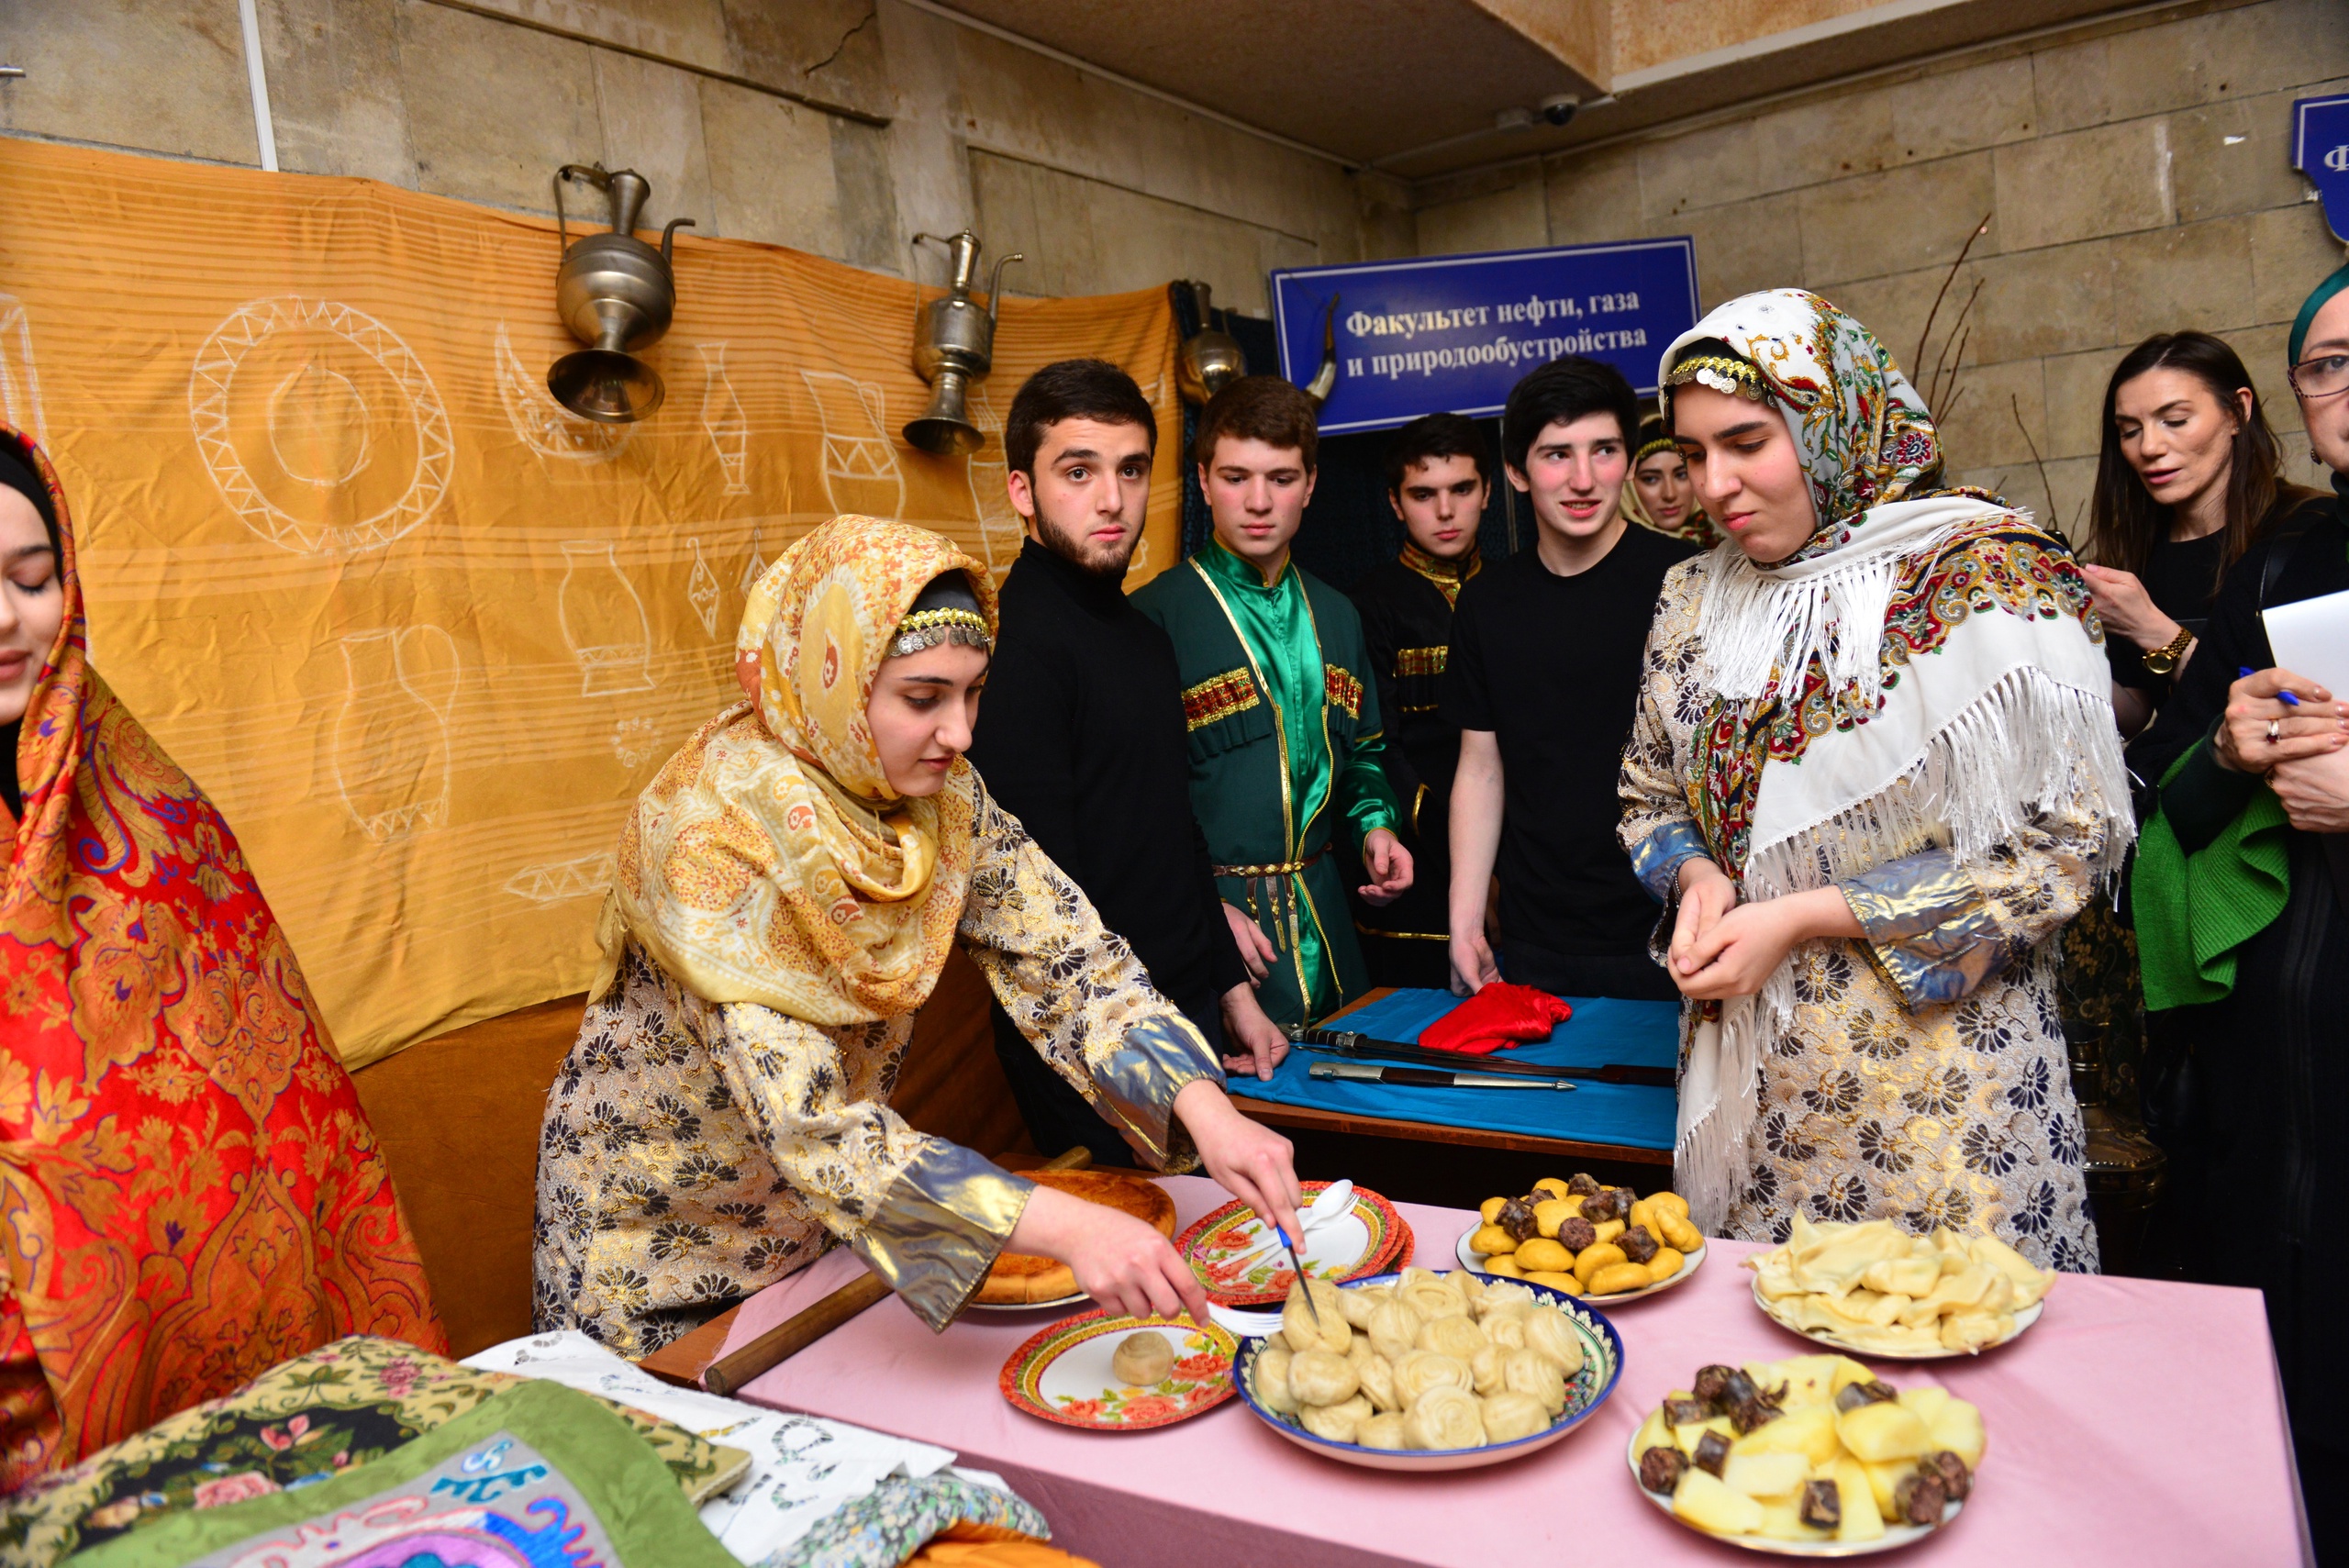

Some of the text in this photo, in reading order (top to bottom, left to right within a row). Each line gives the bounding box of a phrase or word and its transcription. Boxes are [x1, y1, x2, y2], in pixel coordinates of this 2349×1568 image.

[1345, 293, 1640, 339] Факультет нефти, газа
[1347, 328, 1647, 380] и природообустройства
